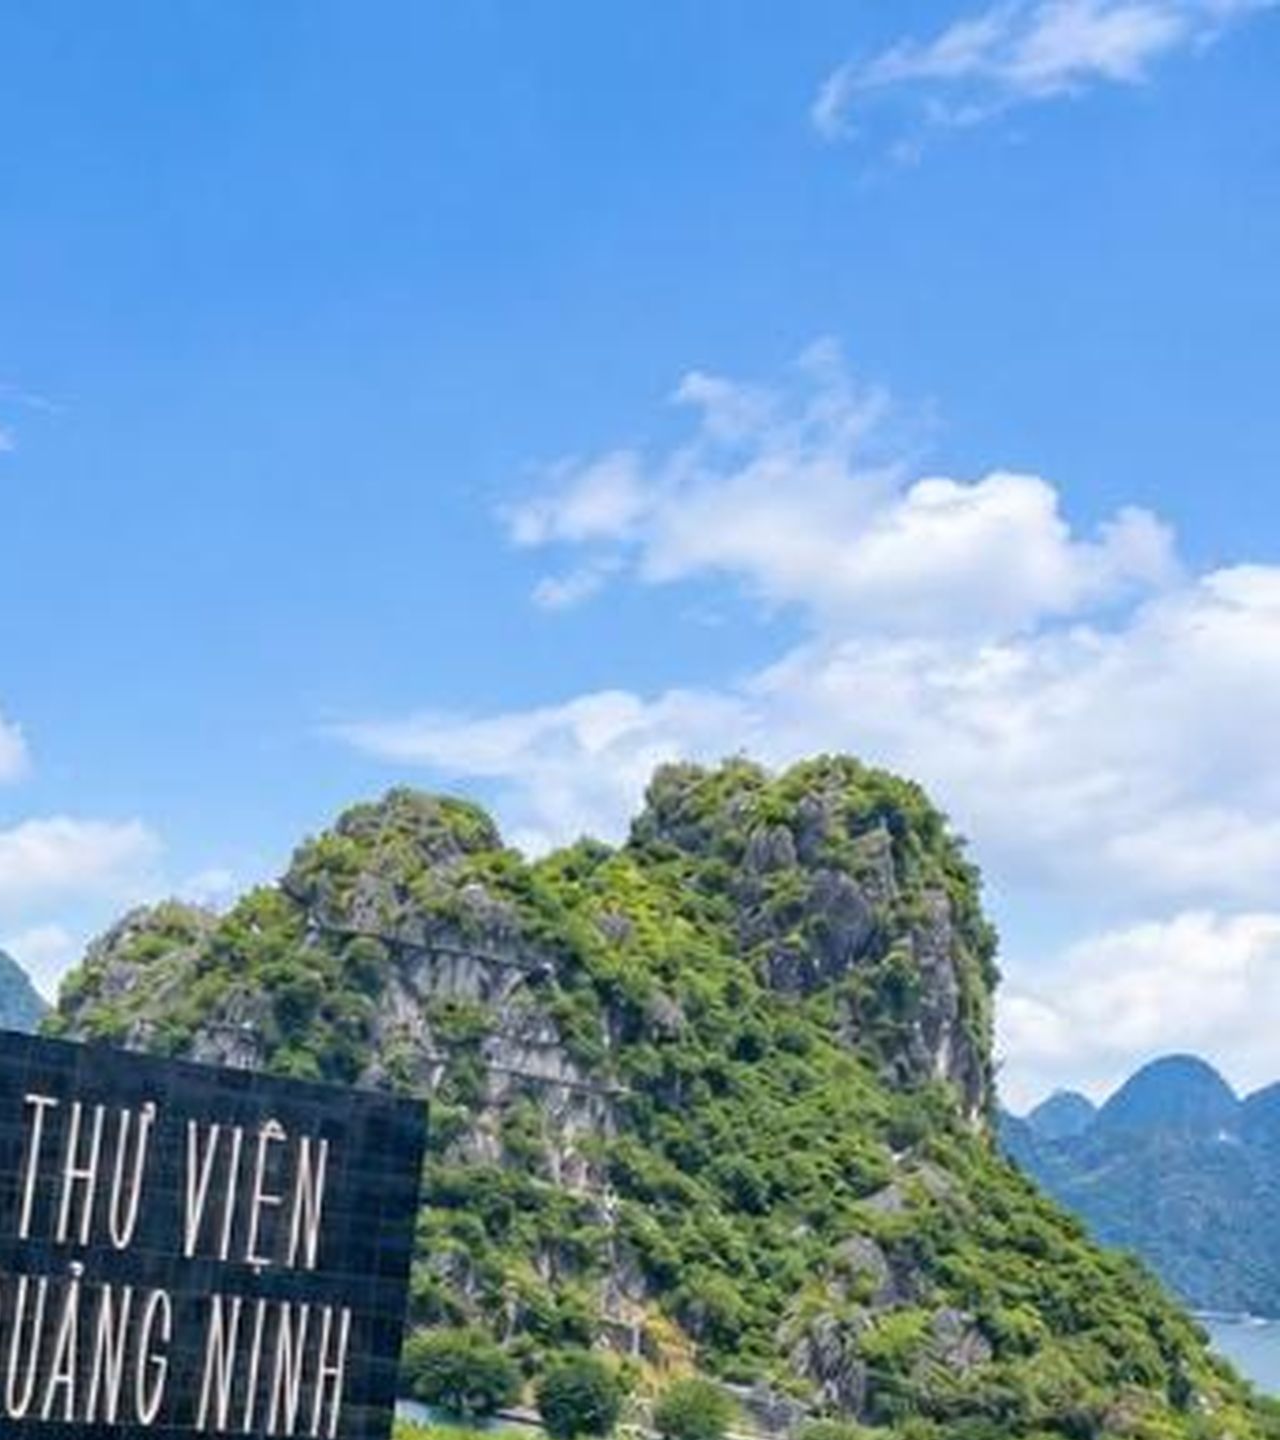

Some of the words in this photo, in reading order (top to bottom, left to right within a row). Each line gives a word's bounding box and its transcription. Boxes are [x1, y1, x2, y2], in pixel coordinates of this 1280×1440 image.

[19, 1093, 156, 1249] THƯ
[184, 1119, 328, 1274] VIỆN
[196, 1294, 351, 1439] NINH
